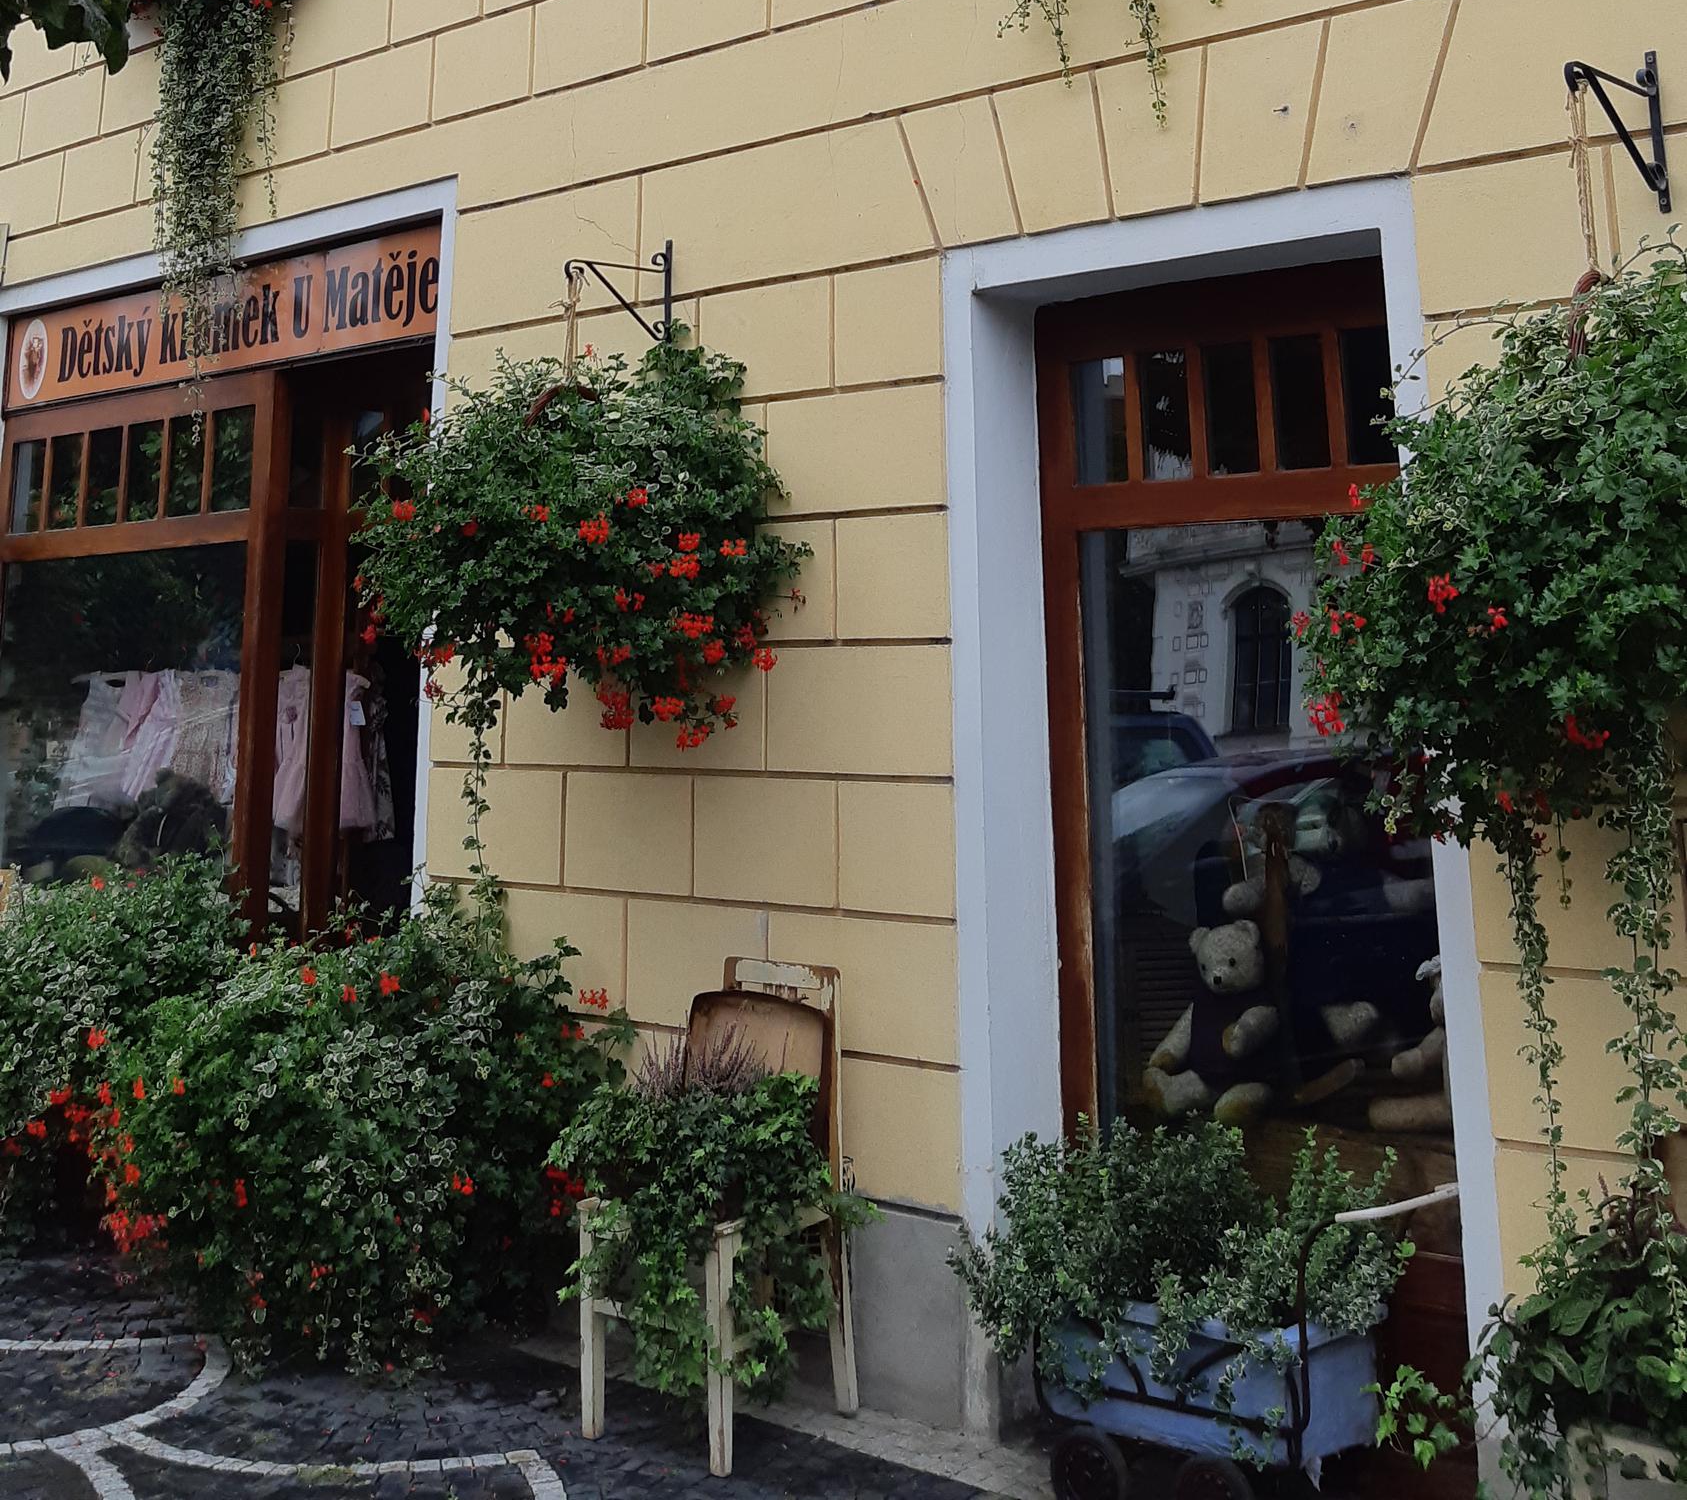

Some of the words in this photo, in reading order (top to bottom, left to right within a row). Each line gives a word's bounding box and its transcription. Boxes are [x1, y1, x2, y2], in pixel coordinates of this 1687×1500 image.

[57, 305, 153, 382] Dětský
[293, 274, 313, 339] U
[323, 250, 438, 333] Matěje
